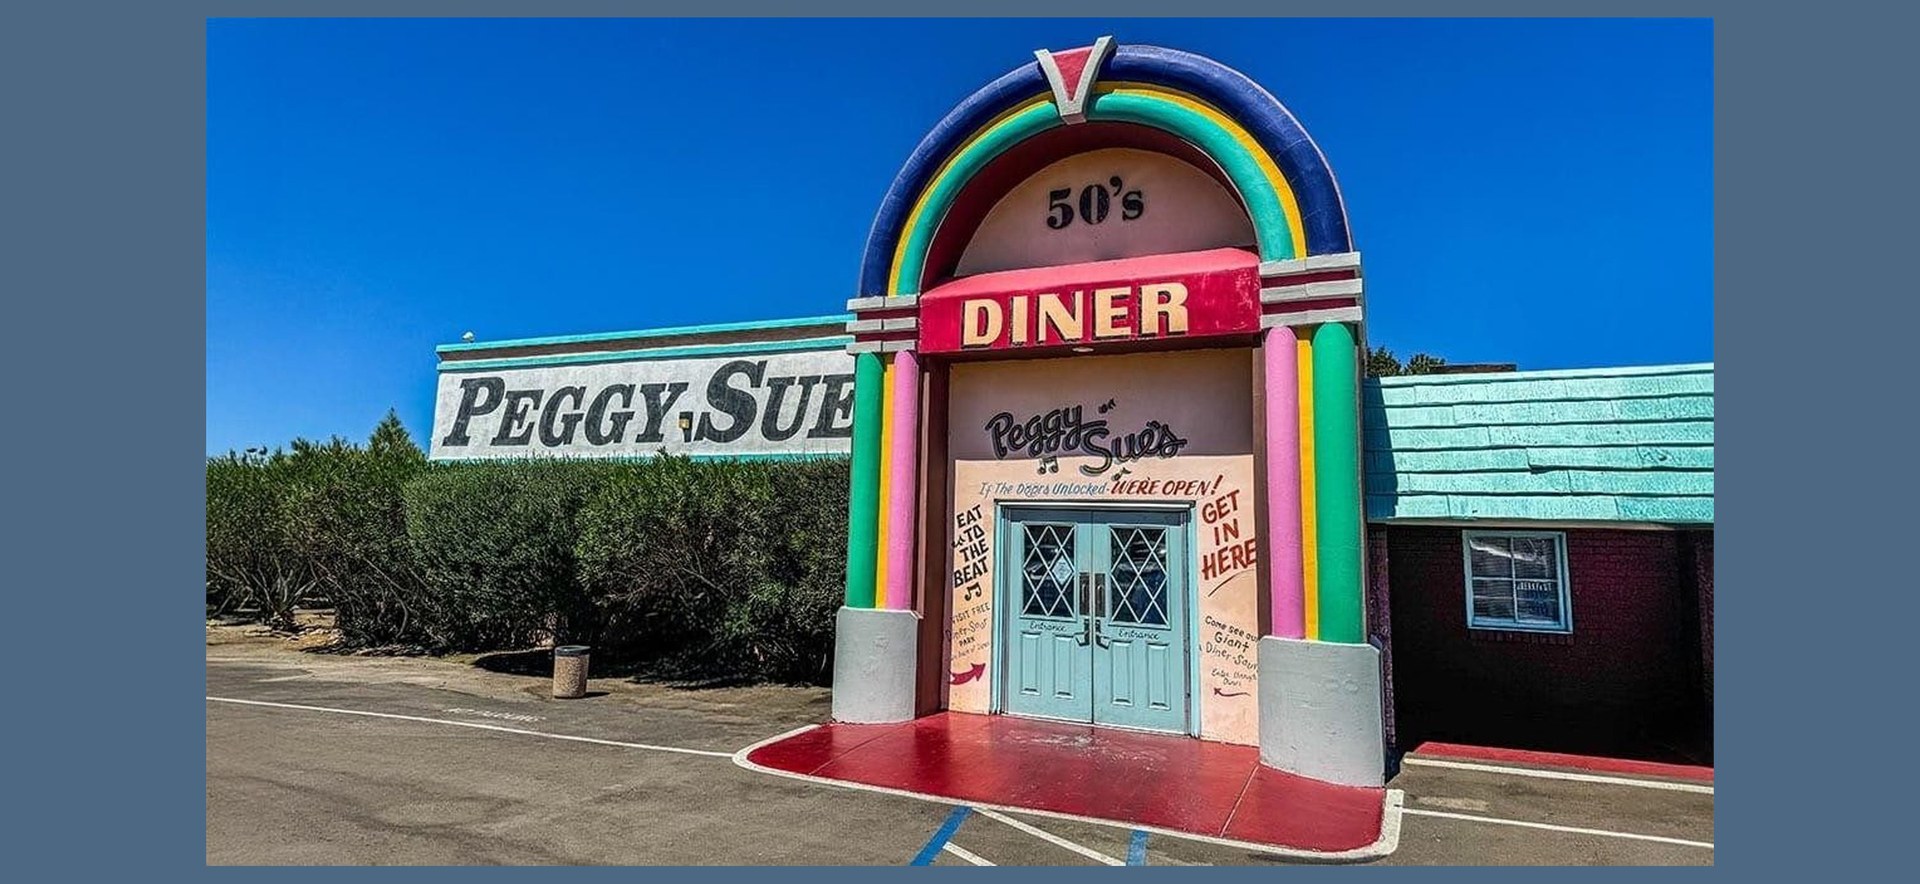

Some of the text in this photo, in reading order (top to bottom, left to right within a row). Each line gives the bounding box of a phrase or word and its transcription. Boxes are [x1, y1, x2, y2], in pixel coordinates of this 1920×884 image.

[1046, 176, 1144, 229] 50's
[961, 282, 1189, 348] DINER
[442, 360, 855, 447] PEGGY SUE
[985, 405, 1107, 459] Peggy
[1079, 420, 1187, 476] Sue's
[994, 481, 1013, 495] The
[1162, 474, 1223, 495] OPEN!
[956, 504, 982, 528] EAT
[1202, 489, 1240, 524] GET
[963, 524, 985, 542] TO
[1214, 518, 1239, 546] IN
[959, 538, 989, 562] THE
[1202, 538, 1256, 580] HERE
[953, 556, 988, 588] BEAT
[971, 602, 991, 615] FREE
[1030, 622, 1067, 632] Entrance
[1119, 629, 1160, 640] Entrance
[1205, 615, 1227, 630] Come
[1229, 625, 1245, 637] see
[1214, 631, 1249, 653] Giant
